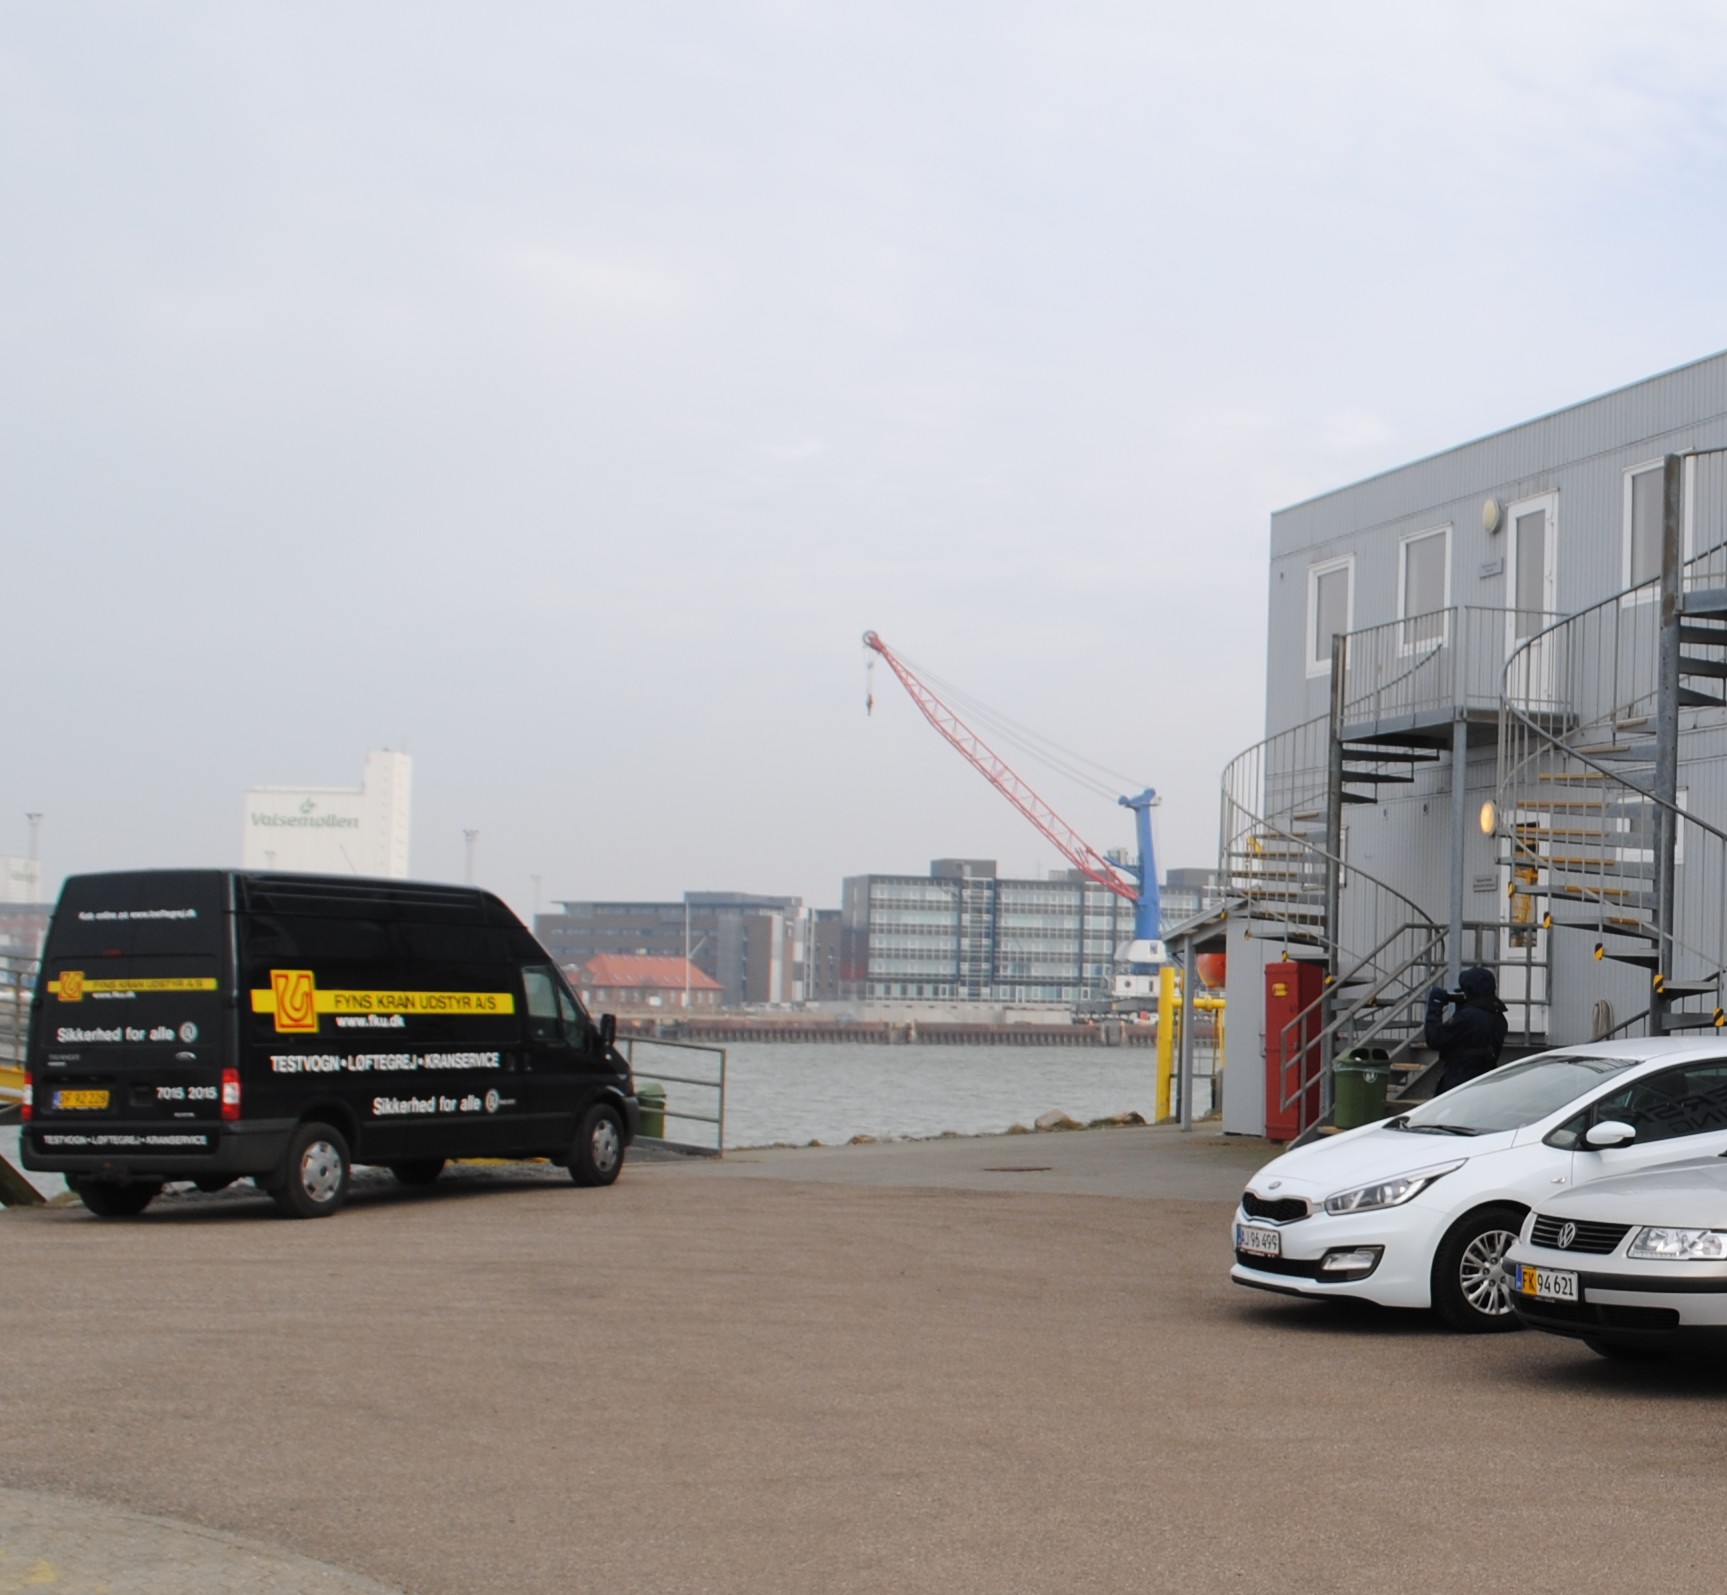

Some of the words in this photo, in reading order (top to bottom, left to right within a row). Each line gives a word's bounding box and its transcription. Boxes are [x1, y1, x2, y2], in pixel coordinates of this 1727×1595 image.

[333, 993, 373, 1009] FYNS
[377, 993, 416, 1010] KRAN
[420, 994, 472, 1010] UDSTYR
[476, 995, 497, 1010] A/S
[336, 1014, 406, 1029] www.fku.dk
[57, 1026, 122, 1043] Sikkerhed
[125, 1026, 146, 1042] for
[149, 1026, 176, 1042] alle
[270, 1054, 341, 1073] TESTVOGN
[424, 1052, 500, 1069] KRANSERVICE
[156, 1086, 185, 1100] 7015
[187, 1086, 218, 1100] 2015
[372, 1096, 436, 1116] Sikkerhed
[439, 1095, 457, 1112] for
[460, 1094, 482, 1112] alle
[1522, 1271, 1536, 1291] FK
[1537, 1273, 1551, 1294] 94
[1553, 1275, 1574, 1297] 621
